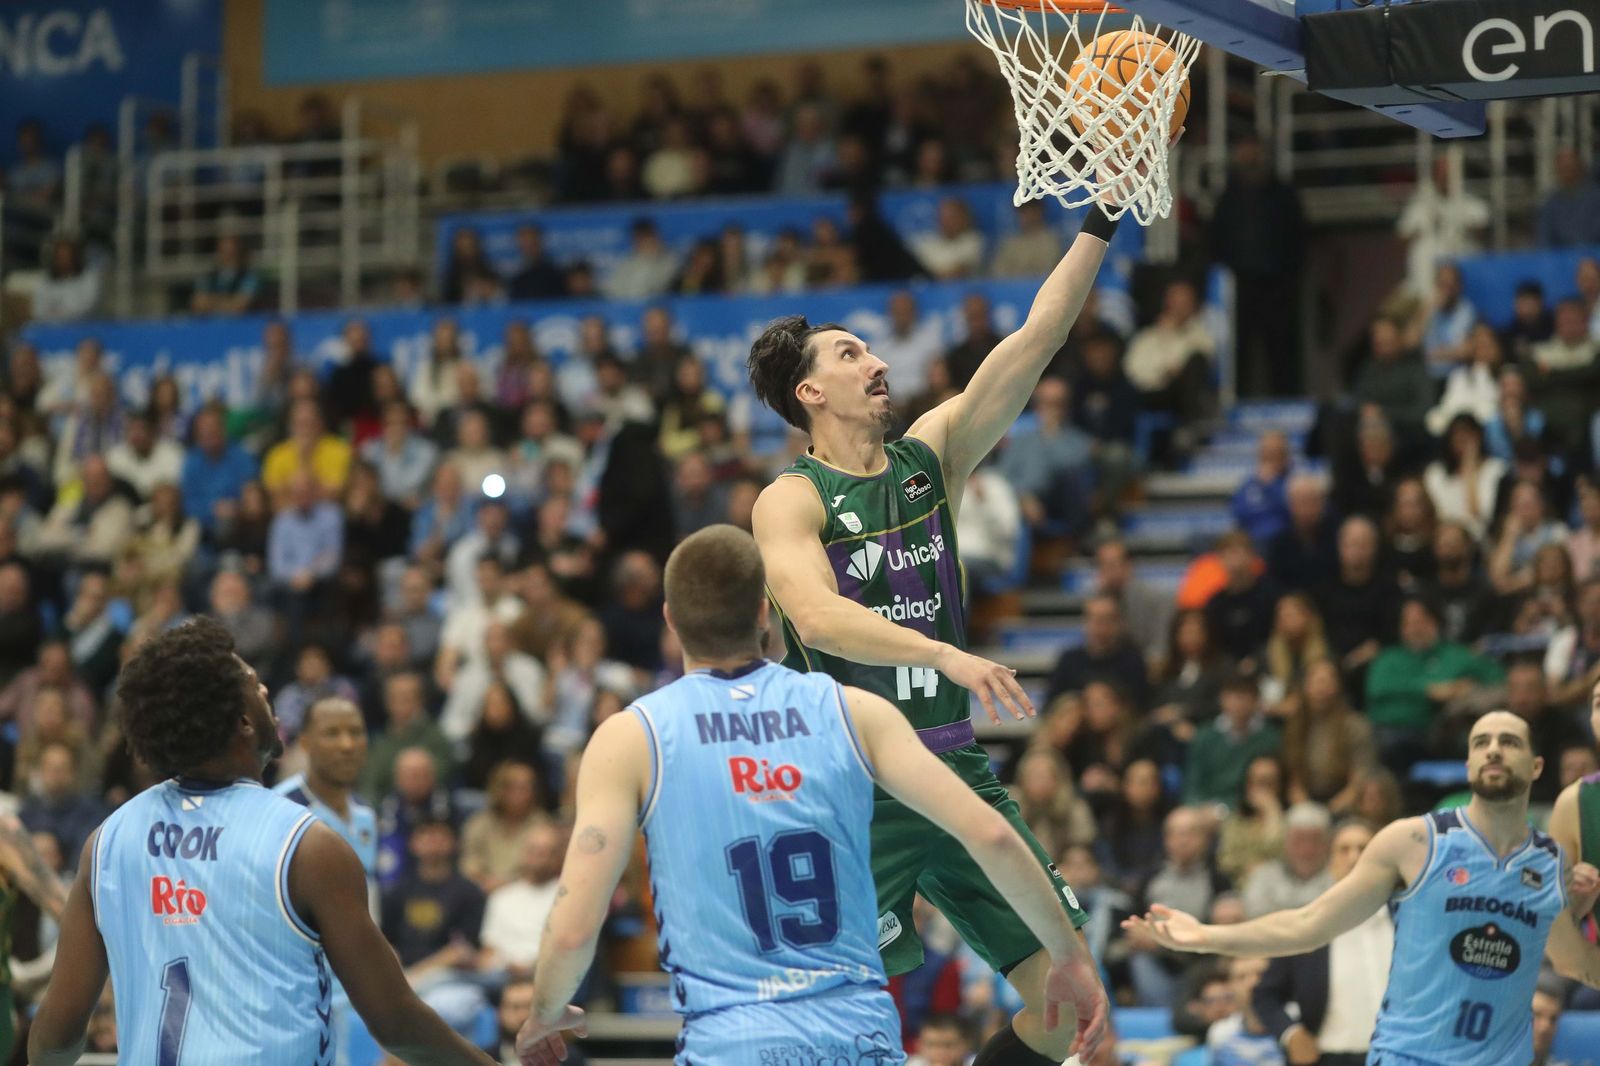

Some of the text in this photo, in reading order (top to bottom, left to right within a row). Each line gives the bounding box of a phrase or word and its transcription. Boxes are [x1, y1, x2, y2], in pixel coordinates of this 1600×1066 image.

[1462, 10, 1594, 82] en
[886, 534, 945, 571] Unicaja
[695, 707, 811, 746] MAVRA
[147, 821, 225, 861] COOK
[724, 827, 842, 955] 19
[1445, 895, 1539, 929] BREOGÁN
[1462, 948, 1508, 969] Galicia
[1463, 933, 1513, 957] Estrella
[155, 957, 193, 1066] 1
[1454, 1000, 1494, 1042] 10
